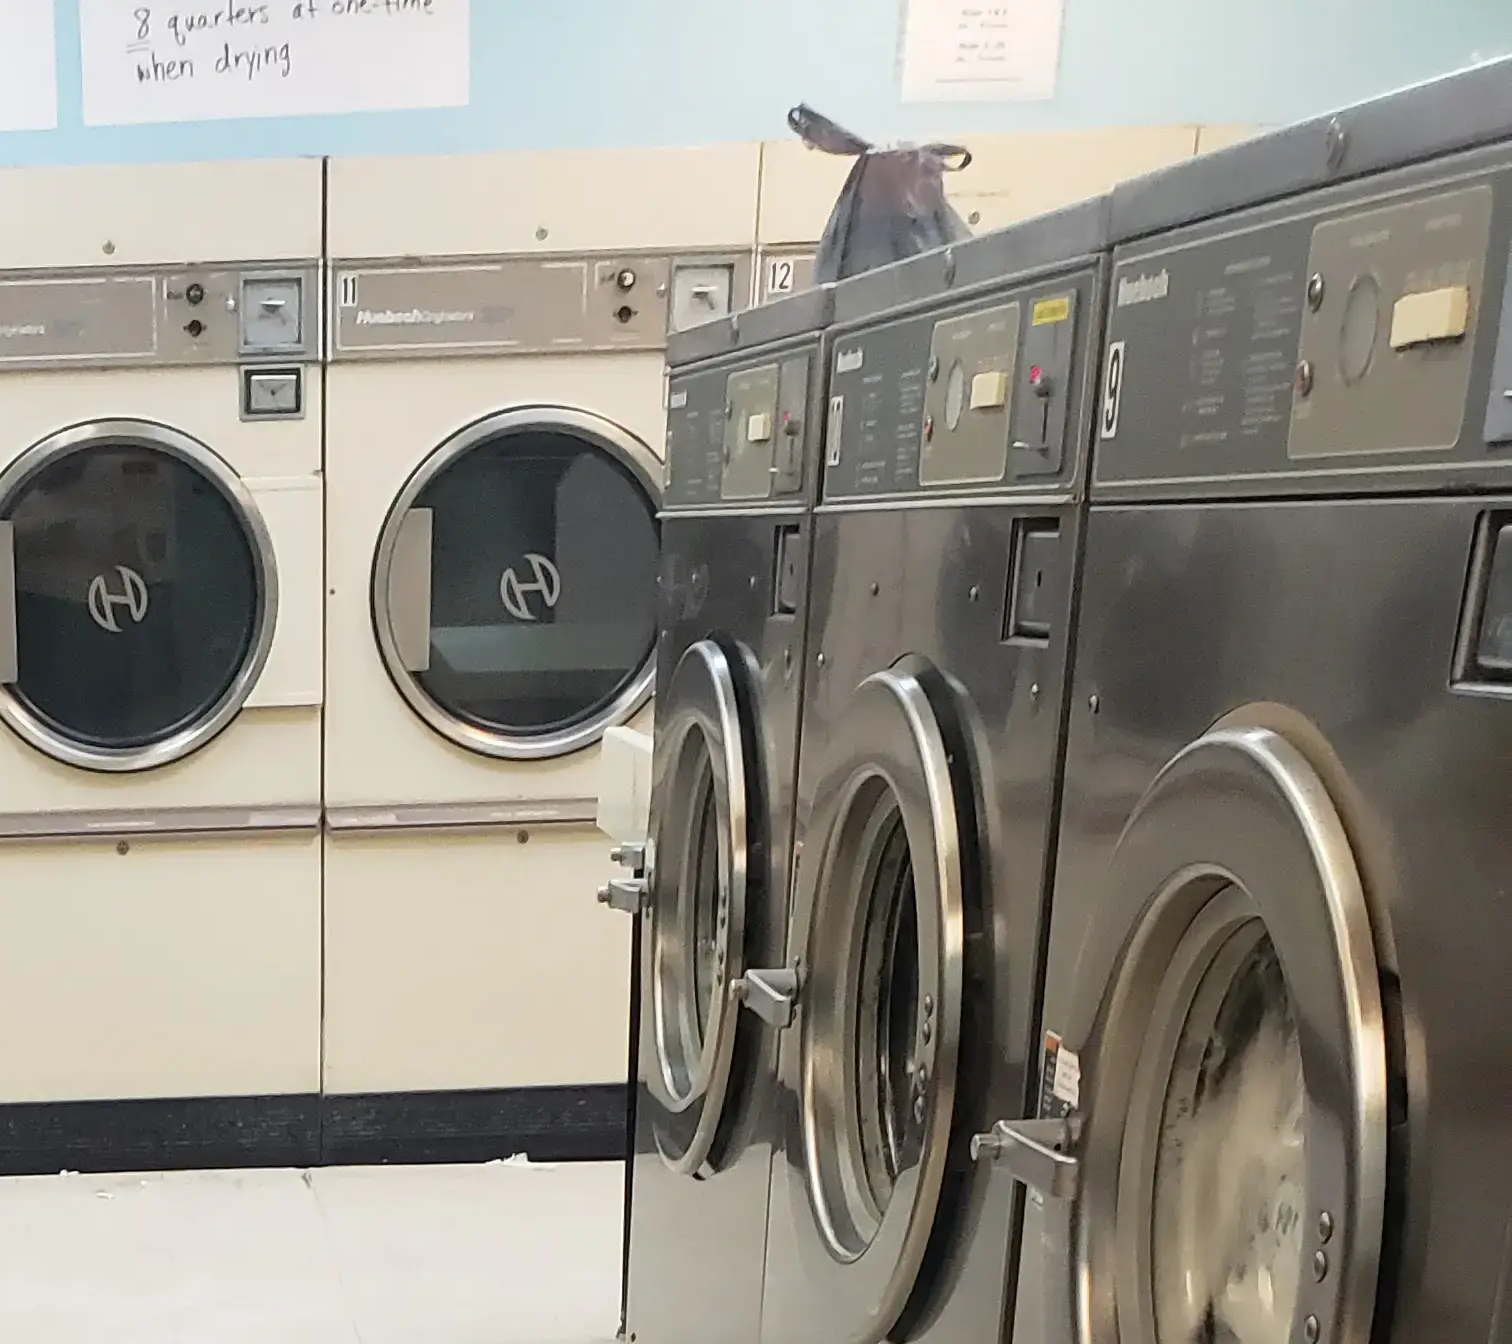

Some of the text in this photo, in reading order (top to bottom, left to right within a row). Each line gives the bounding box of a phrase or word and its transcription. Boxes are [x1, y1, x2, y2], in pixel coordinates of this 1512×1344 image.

[133, 9, 152, 40] 8
[167, 3, 269, 46] quarters
[292, 0, 318, 19] at
[137, 43, 290, 83] when drying
[343, 277, 356, 305] 11
[771, 262, 790, 291] 12
[1105, 348, 1119, 431] 9
